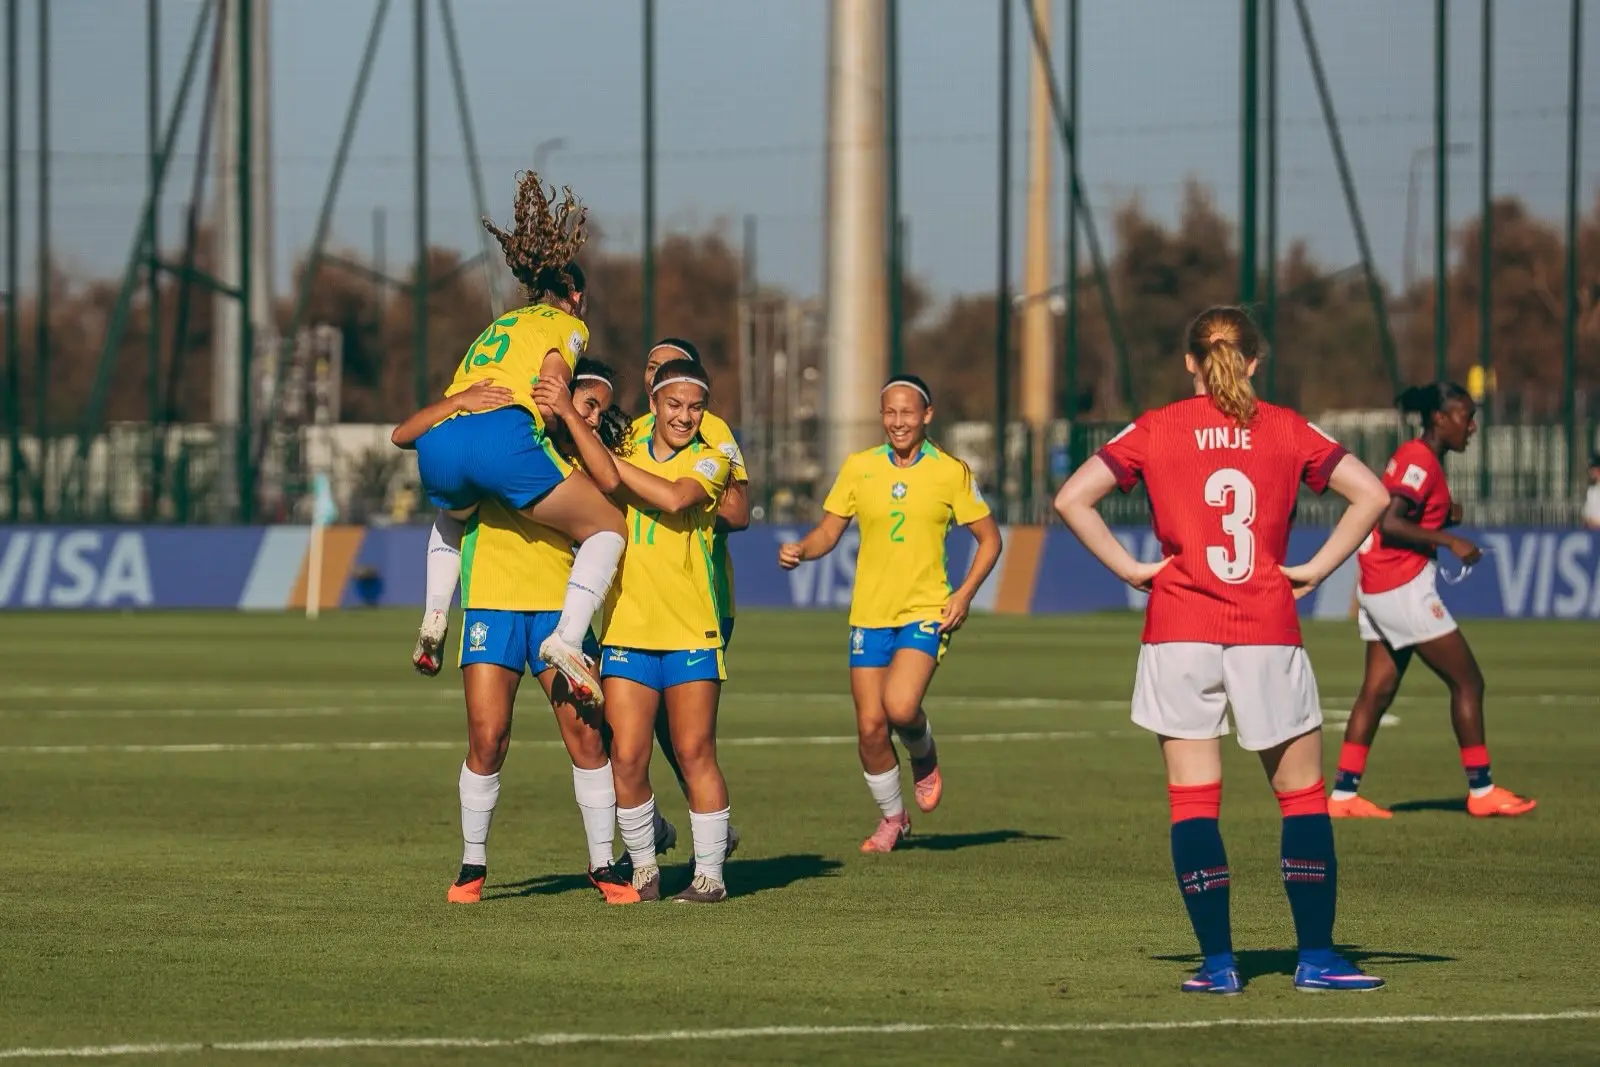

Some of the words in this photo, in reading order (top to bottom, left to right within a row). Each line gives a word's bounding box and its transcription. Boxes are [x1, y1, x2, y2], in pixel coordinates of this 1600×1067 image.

[464, 316, 519, 374] 15
[1194, 426, 1252, 450] VINJE
[890, 510, 906, 543] 2
[1204, 467, 1257, 585] 3
[1482, 531, 1600, 618] VIS
